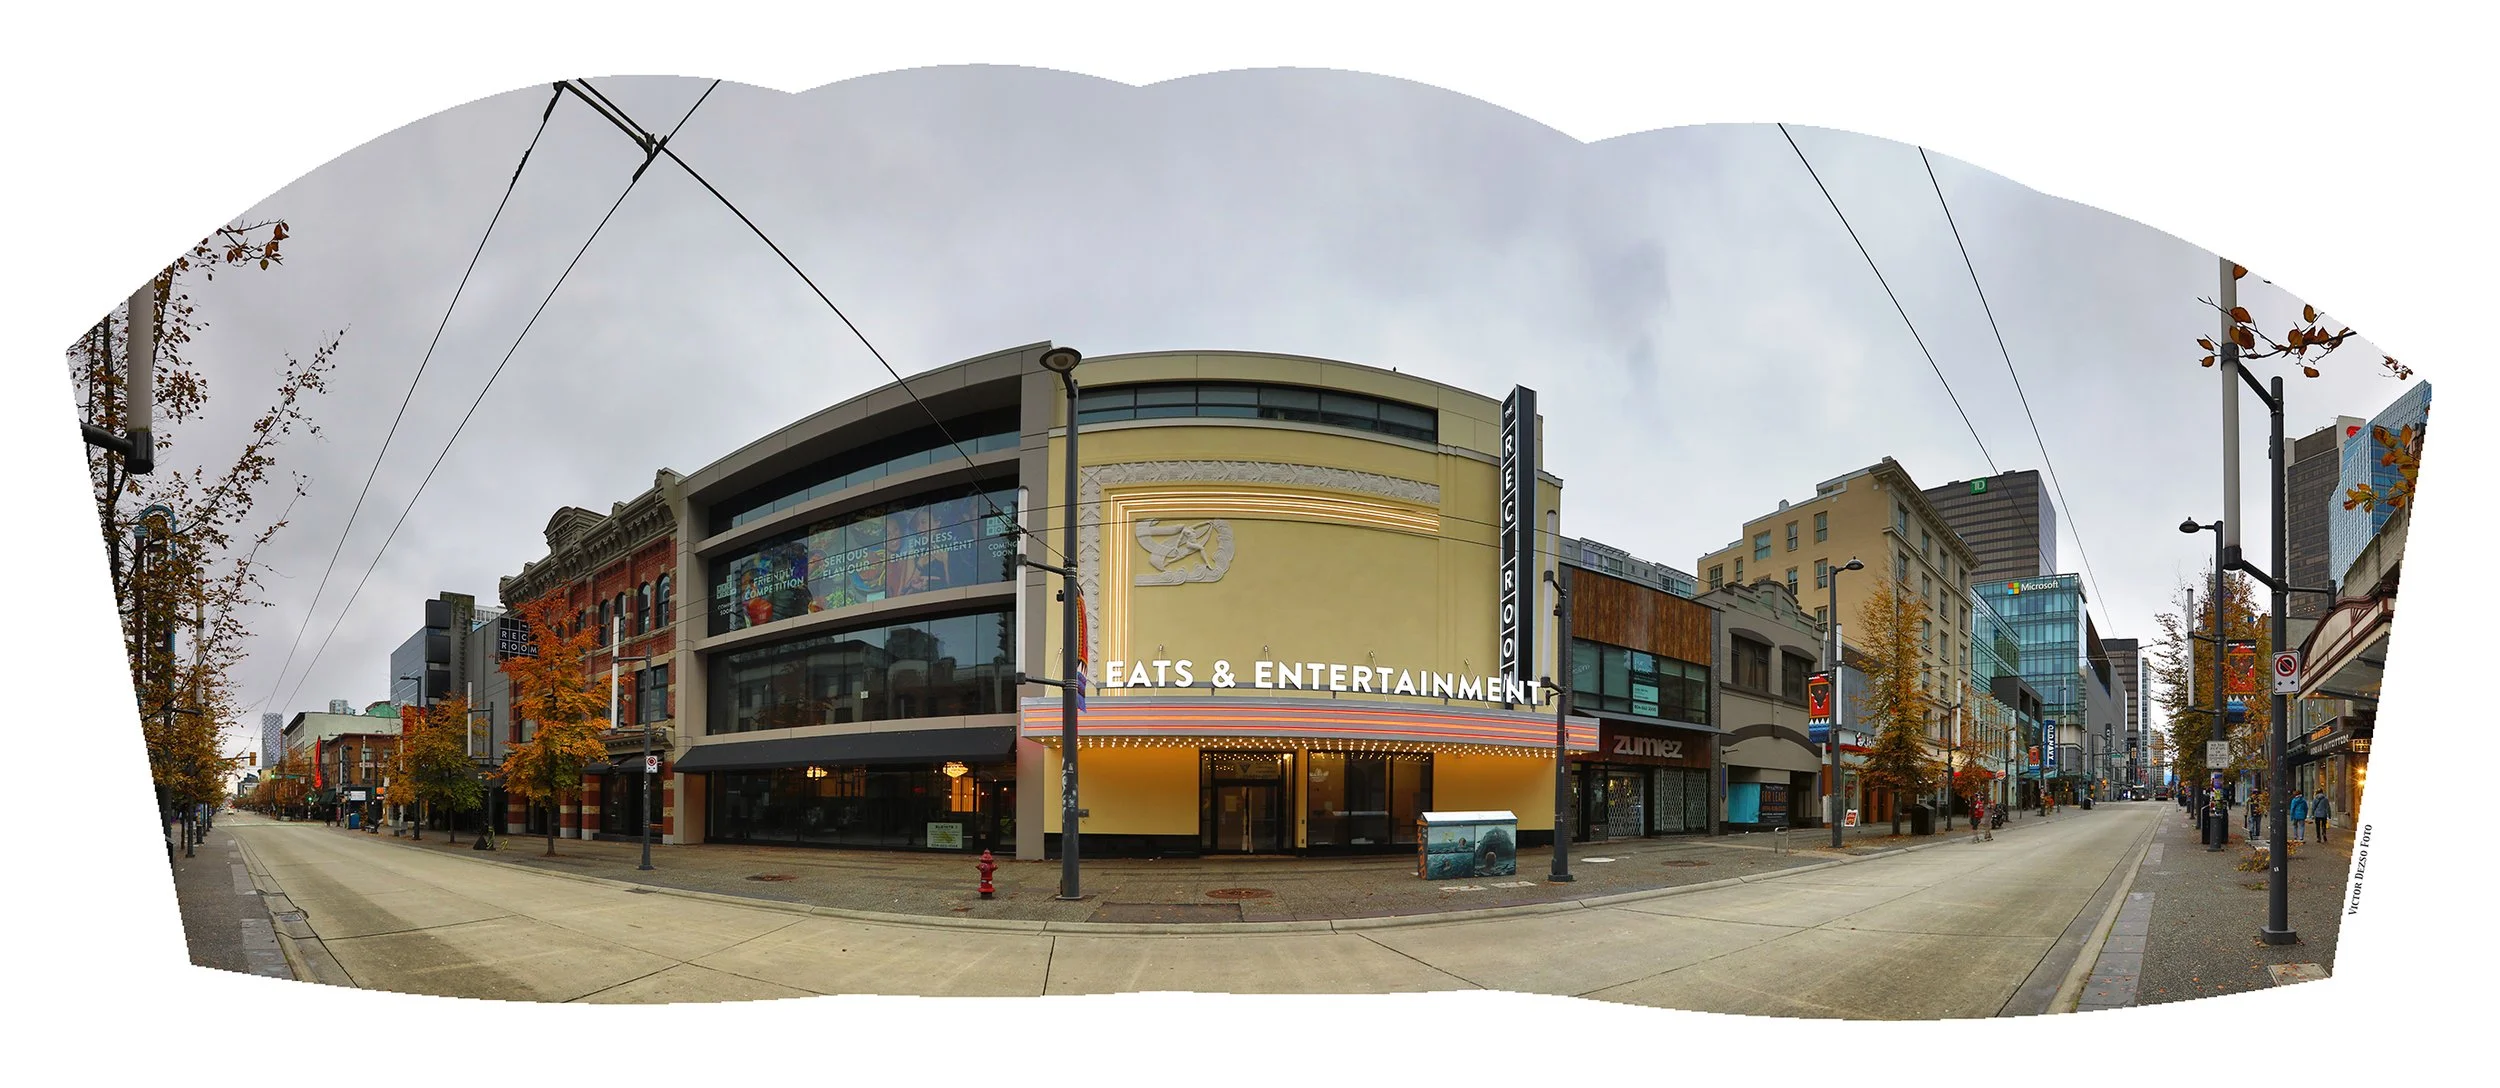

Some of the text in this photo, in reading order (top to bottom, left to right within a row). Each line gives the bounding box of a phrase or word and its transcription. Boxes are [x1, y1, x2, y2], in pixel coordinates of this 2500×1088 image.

[1504, 434, 1514, 523] REC
[1972, 480, 1986, 491] TD
[823, 547, 869, 568] SERIOUS
[889, 539, 975, 563] ENTERTAINMENT
[992, 549, 1014, 558] SOON
[753, 566, 796, 587] FRIENDLY
[2021, 580, 2059, 592] Microsoft
[744, 576, 805, 600] COMPETITION
[501, 630, 527, 641] REC
[501, 641, 537, 653] ROOM
[1106, 659, 1194, 688] EATS
[1211, 659, 1236, 688] &
[1254, 660, 1541, 705] ENTERTAINMENT
